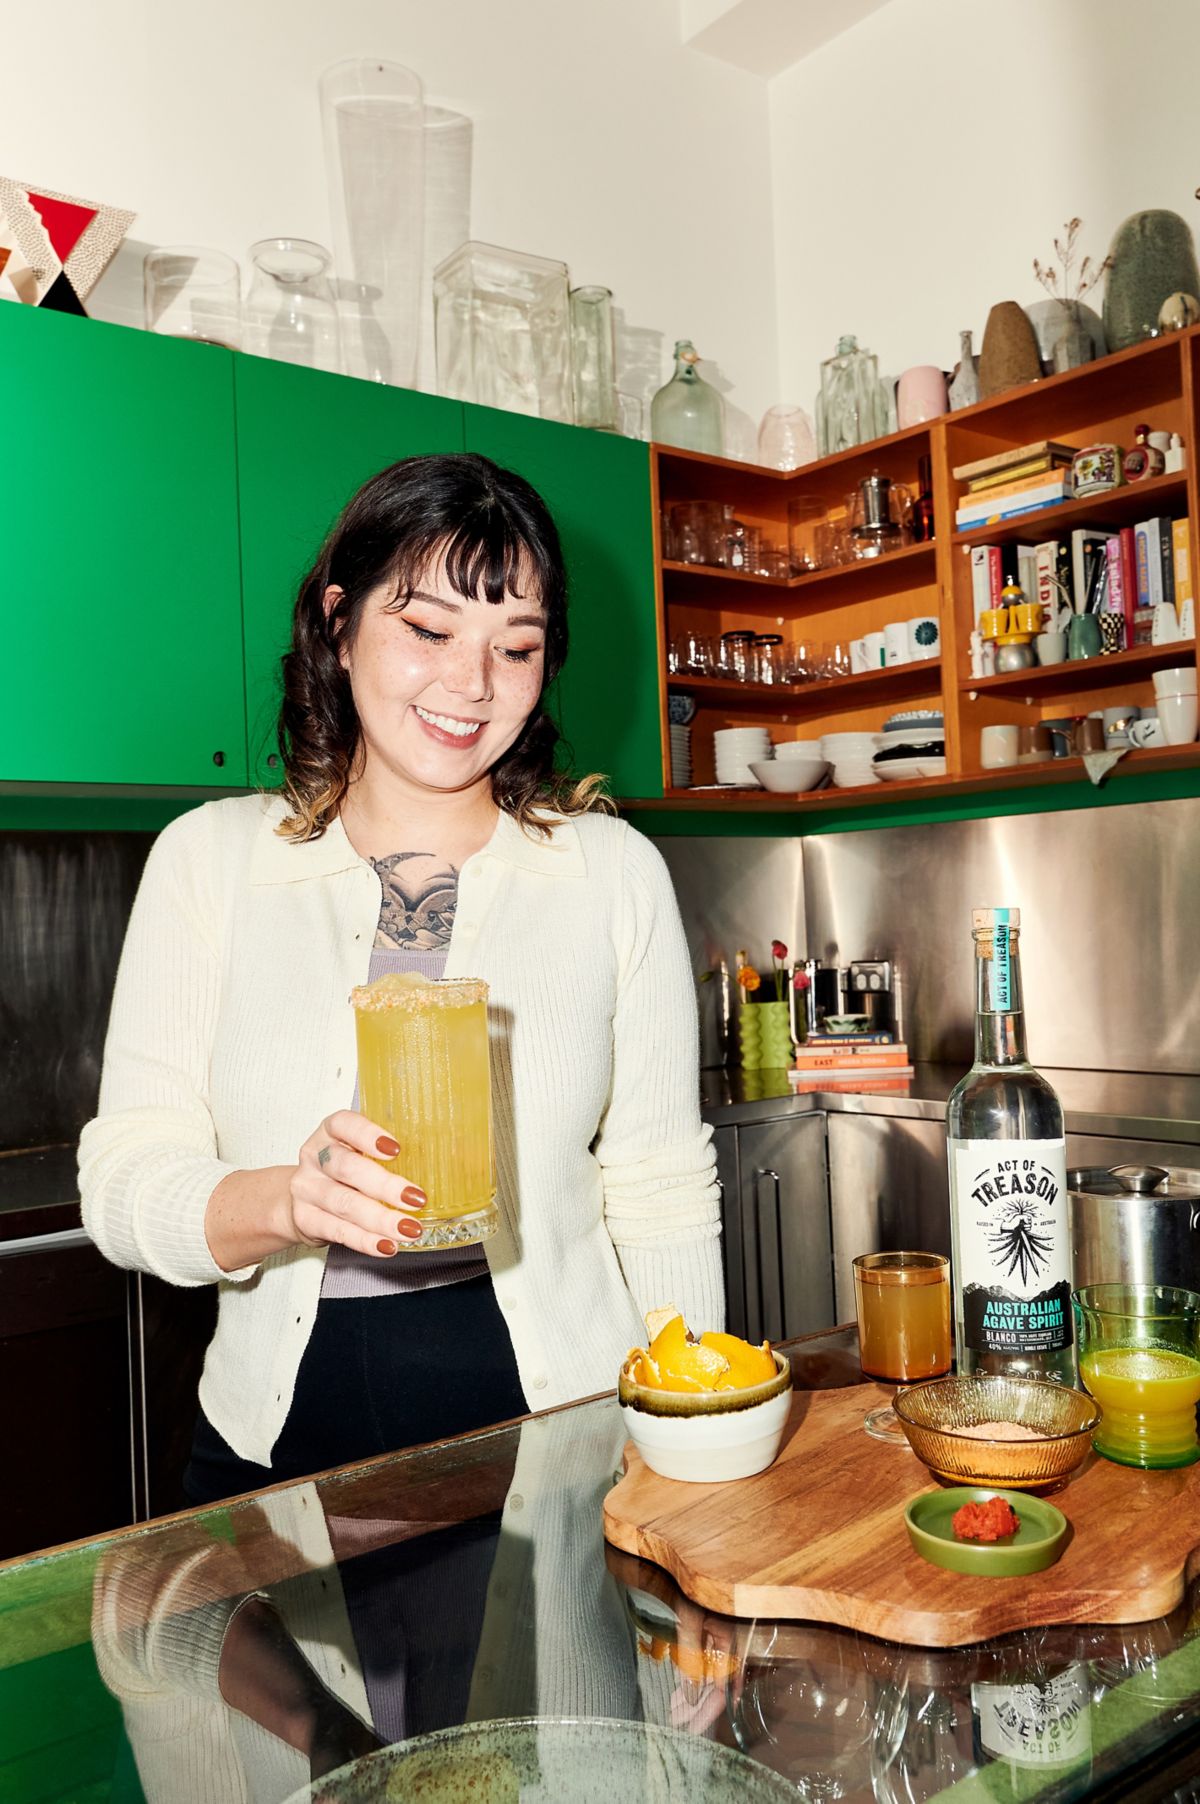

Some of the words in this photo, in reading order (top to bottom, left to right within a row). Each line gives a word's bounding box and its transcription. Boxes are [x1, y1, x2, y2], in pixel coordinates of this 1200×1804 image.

[996, 924, 1008, 967] TREASON
[996, 971, 1007, 983] OF
[996, 986, 1008, 1004] ACT
[997, 1160, 1018, 1173] ACT
[1023, 1160, 1035, 1171] OF
[971, 1173, 1059, 1207] TREASON
[986, 1298, 1061, 1316] AUSTRALIAN
[983, 1315, 1024, 1330] AGAVE
[1029, 1312, 1064, 1329] SPIRIT
[986, 1331, 1017, 1343] BLANCO
